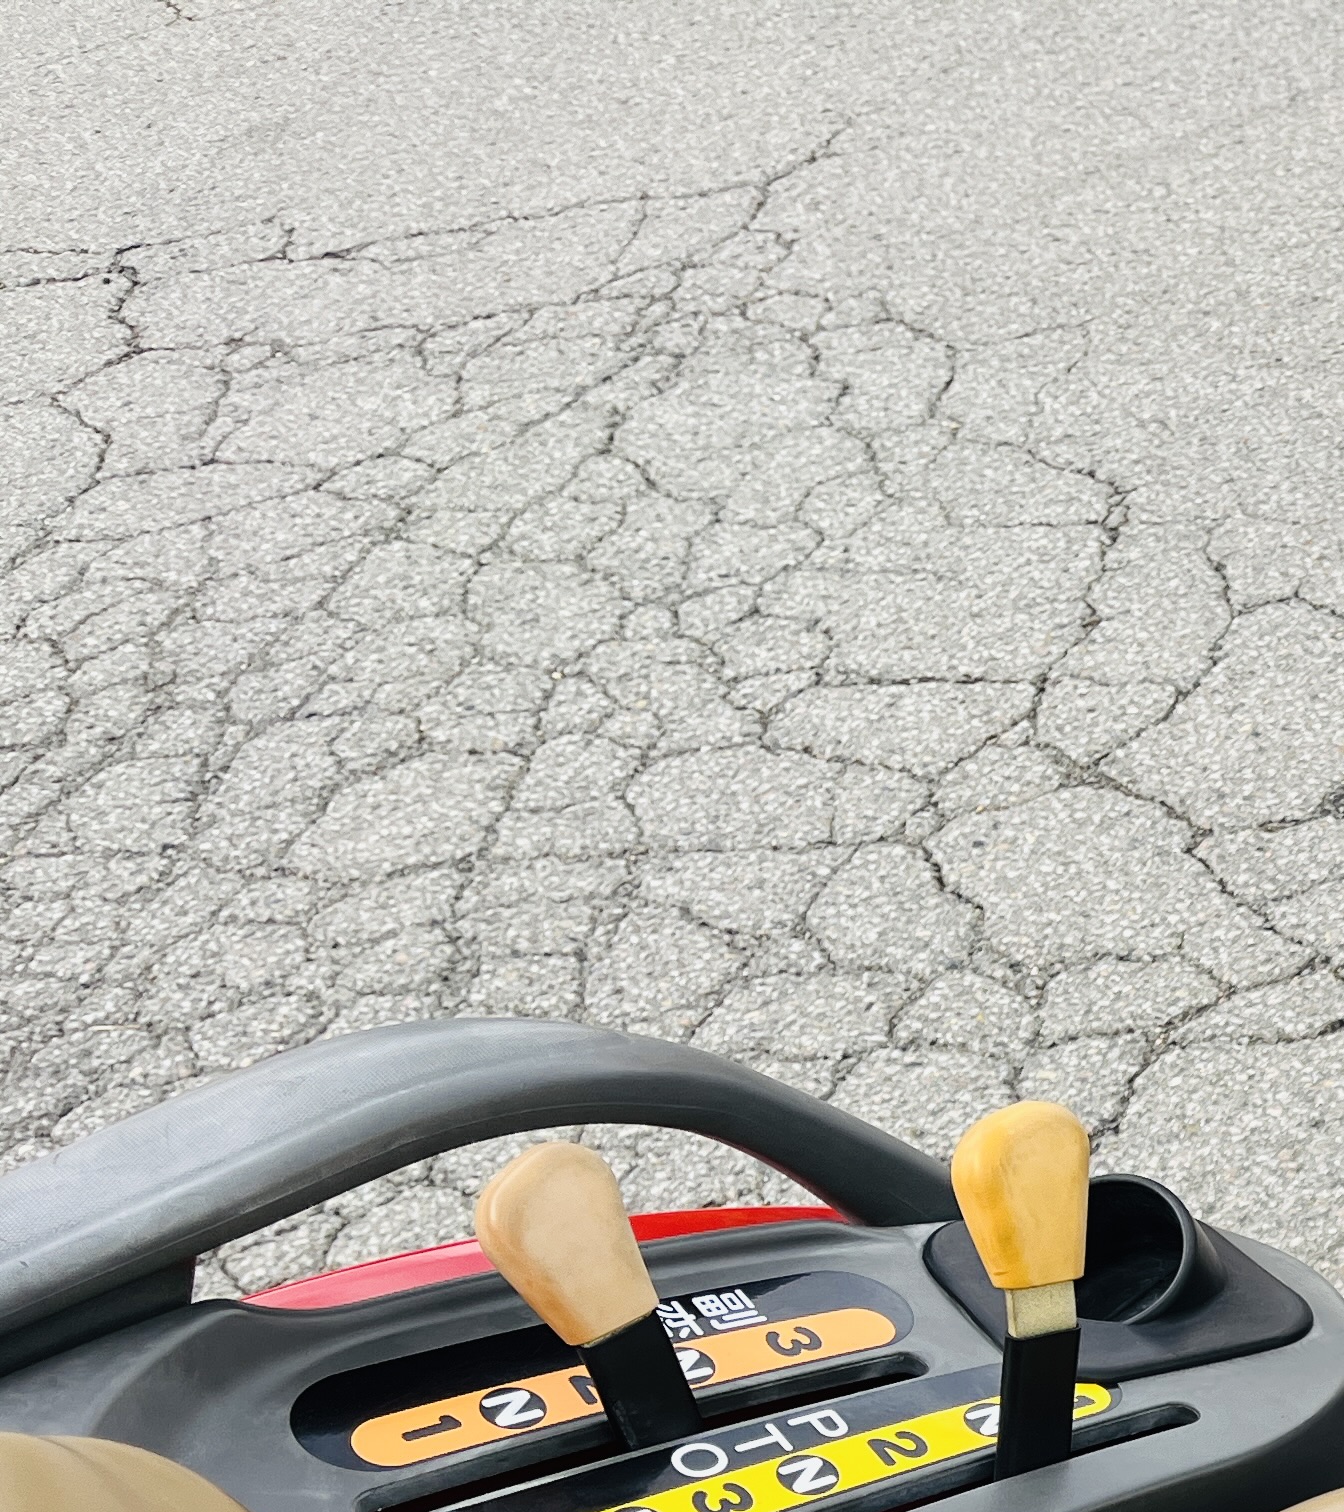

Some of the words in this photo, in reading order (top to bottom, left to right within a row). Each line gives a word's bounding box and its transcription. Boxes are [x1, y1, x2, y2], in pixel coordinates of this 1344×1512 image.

[401, 1414, 462, 1442] 1
[480, 1391, 546, 1427] N
[765, 1325, 823, 1357] 3
[671, 1408, 849, 1478] PTO
[777, 1457, 839, 1496] N
[867, 1431, 929, 1467] 2
